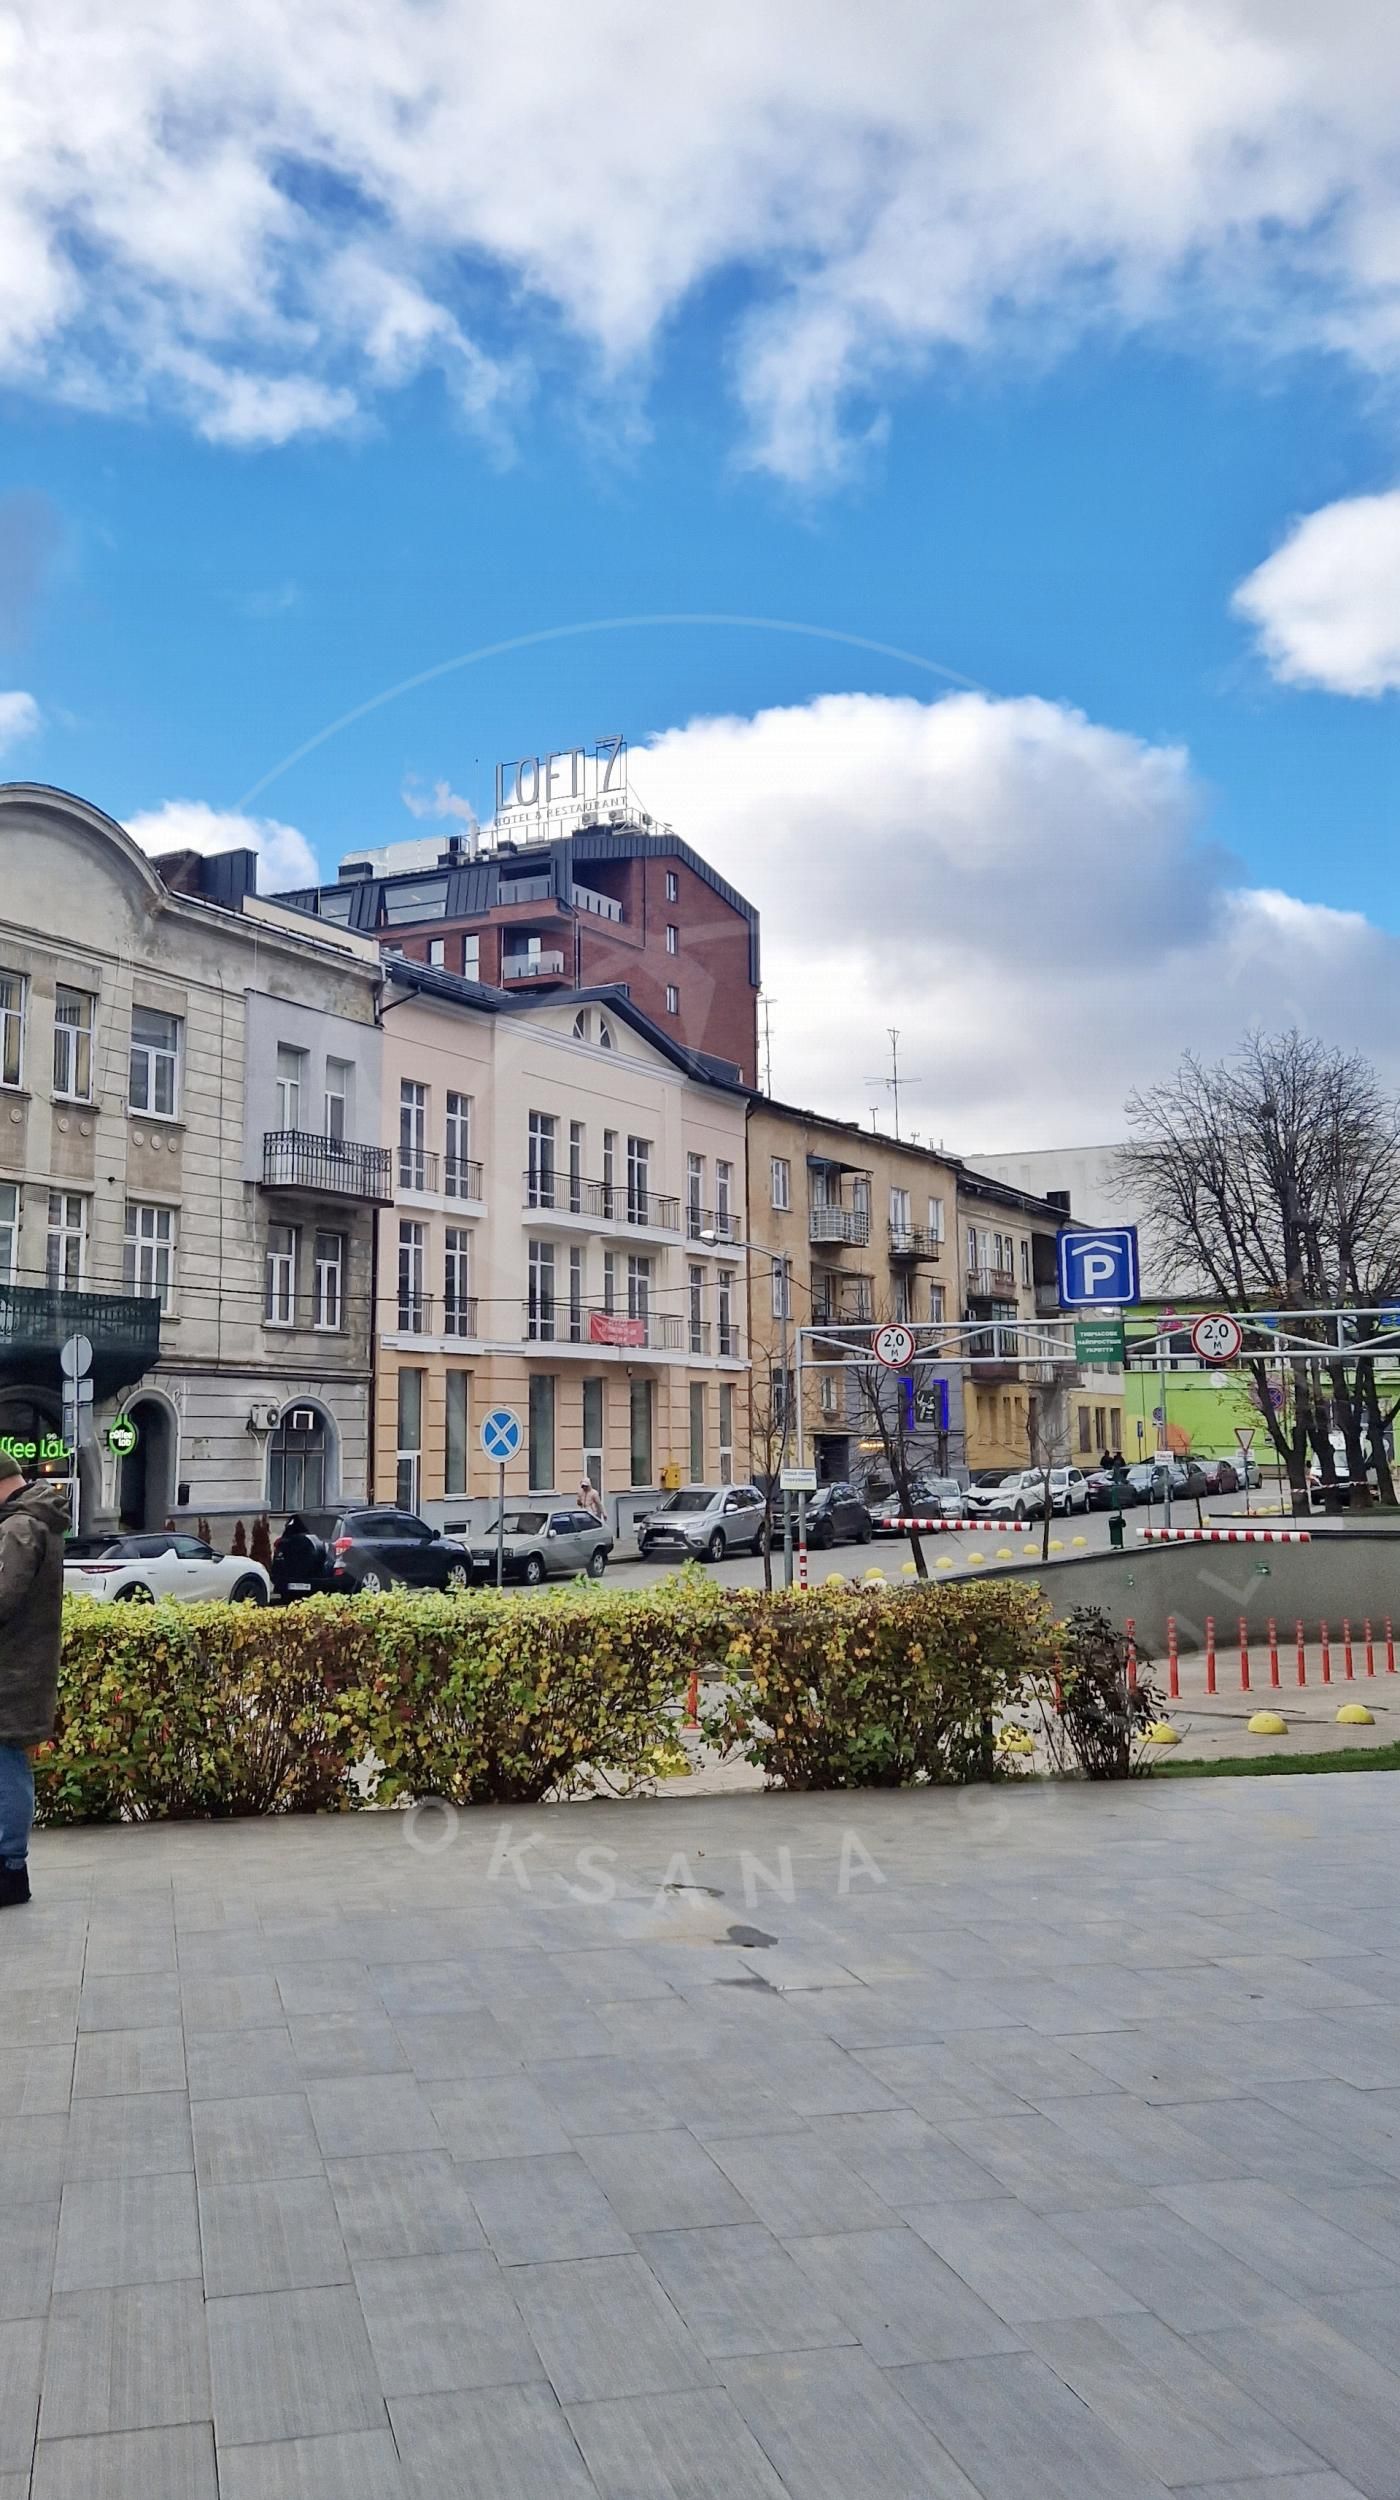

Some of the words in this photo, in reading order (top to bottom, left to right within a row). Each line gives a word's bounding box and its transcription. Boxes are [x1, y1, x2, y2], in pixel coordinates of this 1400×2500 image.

[496, 746, 585, 811] LOFT
[494, 813, 531, 827] HOTEL
[546, 796, 627, 818] RESTAURANT
[1083, 1255, 1115, 1294] P
